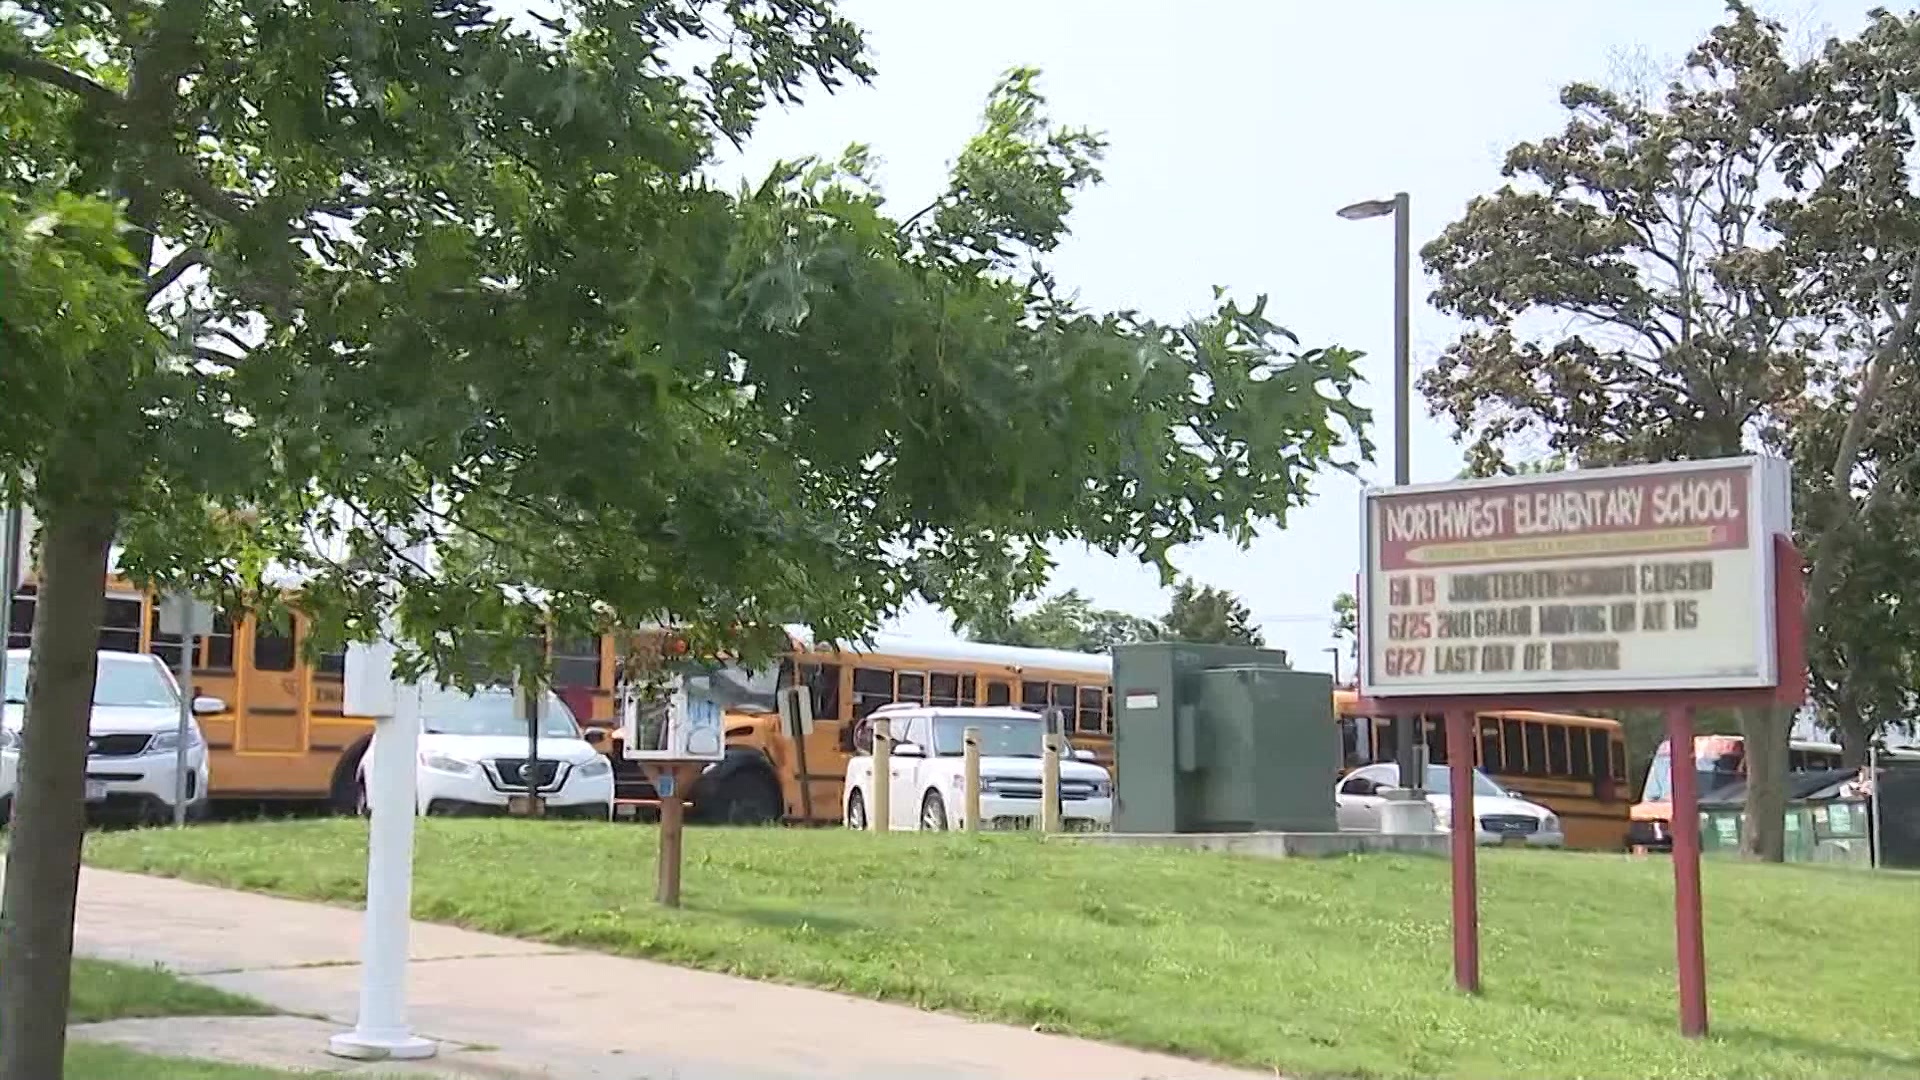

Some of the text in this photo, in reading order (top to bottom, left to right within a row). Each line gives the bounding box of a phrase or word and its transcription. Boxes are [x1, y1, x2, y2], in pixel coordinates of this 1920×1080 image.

[1387, 477, 1740, 542] NORTHWEST ELEMENTARY SCHOOL
[1388, 611, 1432, 640] 6/25
[1641, 601, 1668, 631] AT
[1385, 647, 1427, 677] 6/27
[1434, 644, 1479, 674] LAST
[1522, 641, 1547, 671] OF
